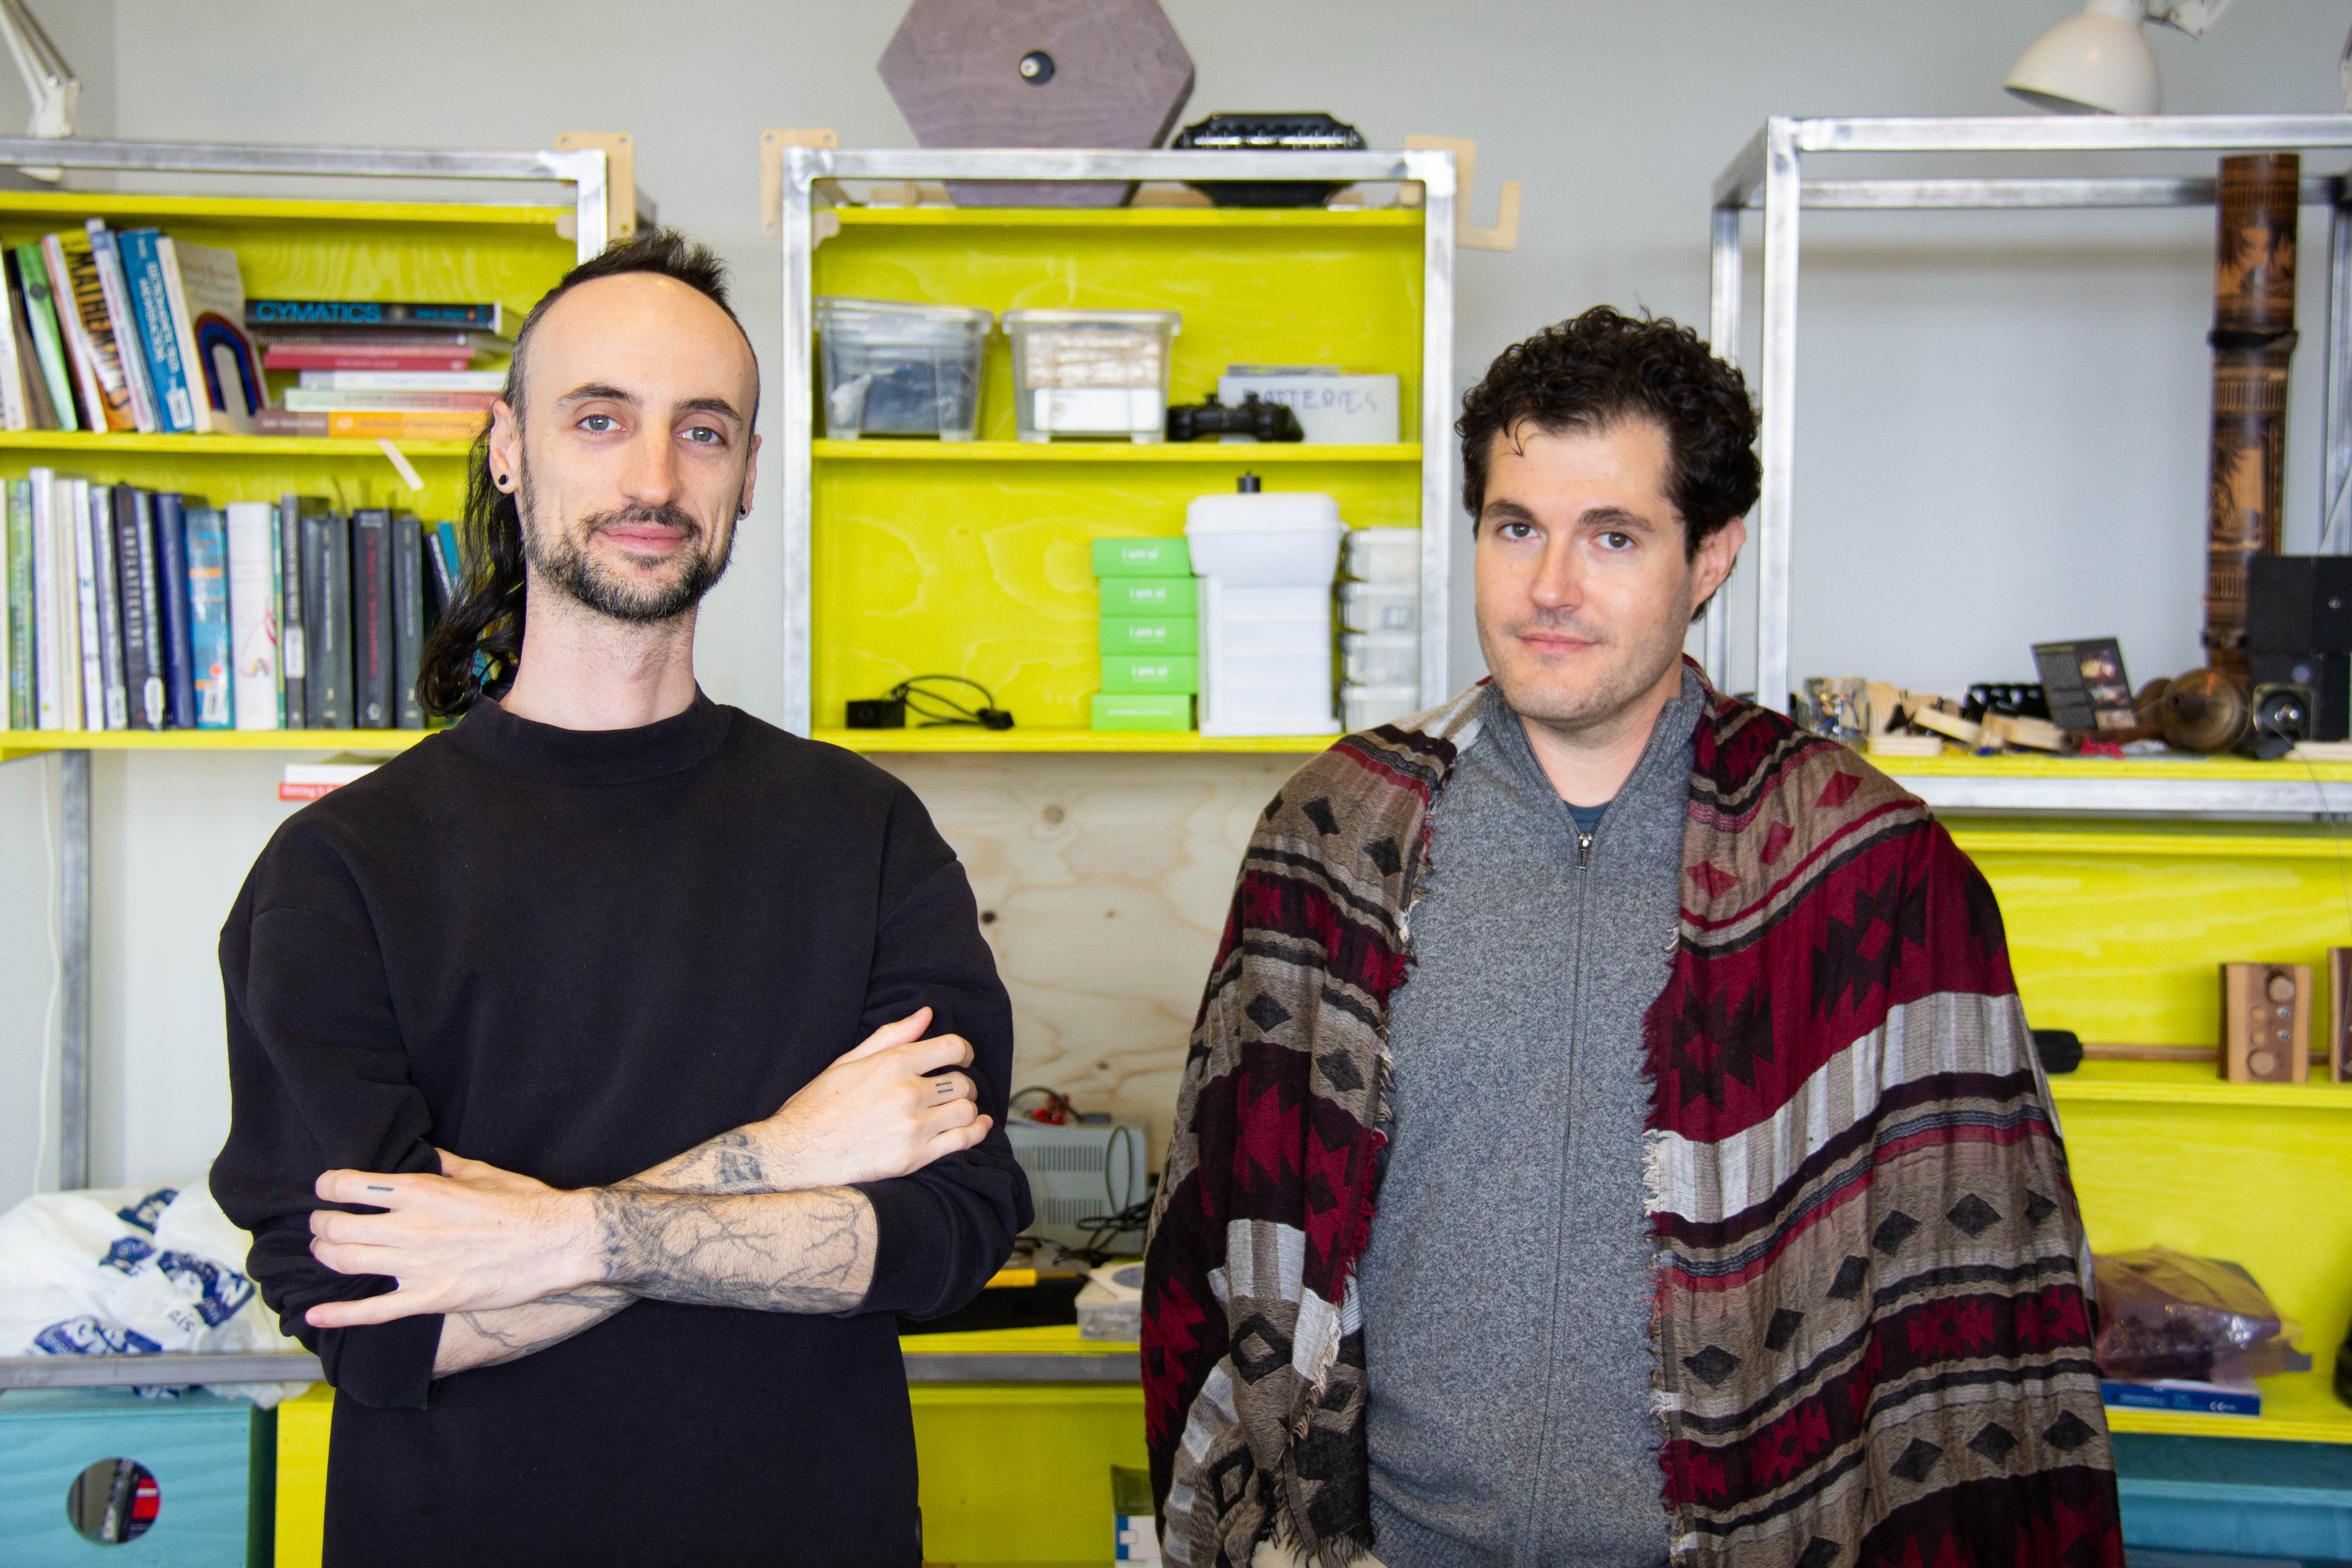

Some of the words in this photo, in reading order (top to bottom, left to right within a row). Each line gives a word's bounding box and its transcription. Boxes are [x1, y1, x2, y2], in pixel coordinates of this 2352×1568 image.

[256, 300, 381, 323] CYMATICS
[1128, 550, 1145, 559] am
[1136, 589, 1152, 598] am
[1135, 628, 1152, 637] am
[1138, 667, 1154, 676] am
